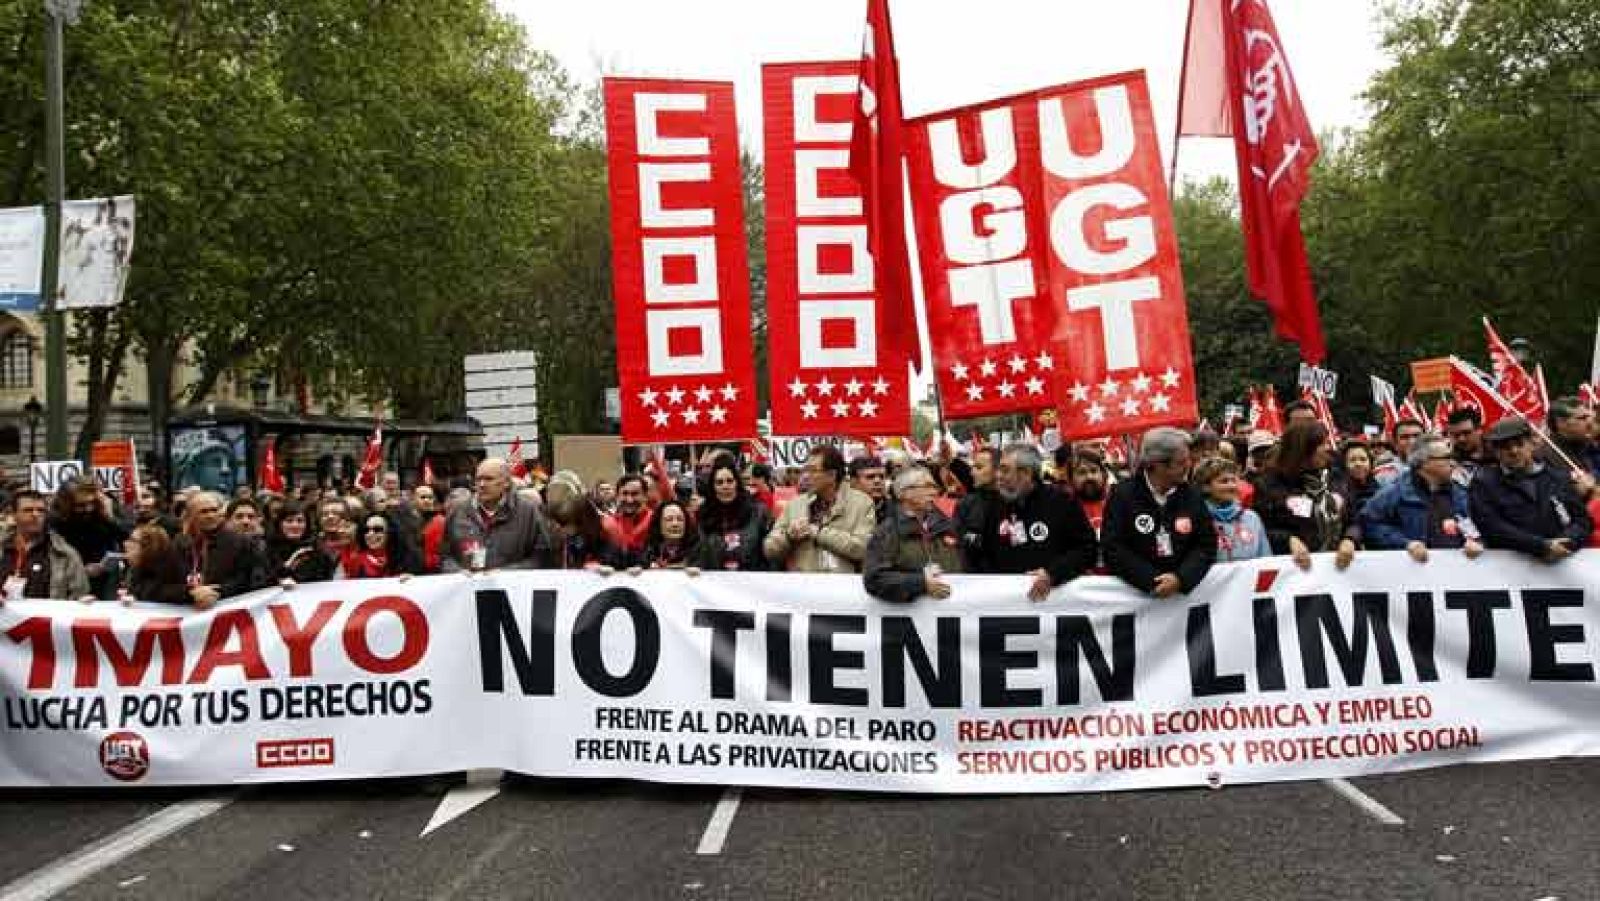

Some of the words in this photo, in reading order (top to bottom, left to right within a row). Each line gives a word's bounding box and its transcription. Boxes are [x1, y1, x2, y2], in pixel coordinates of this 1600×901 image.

[928, 106, 1036, 344] UGT
[1039, 85, 1161, 370] UGT
[476, 586, 661, 698] NO
[694, 608, 1135, 708] TIENEN
[1187, 570, 1595, 698] LÍMITE
[7, 697, 107, 729] LUCHA
[119, 693, 182, 727] POR
[193, 689, 249, 723] TUS
[260, 680, 432, 720] DERECHOS
[595, 708, 672, 733] FRENTE
[678, 711, 708, 735] AL
[716, 712, 808, 737] DRAMA
[815, 716, 861, 740] DEL
[868, 719, 936, 741] PARO
[958, 711, 1145, 742] REACTIVACIÓN
[1153, 704, 1309, 735] ECONÓMICA
[1315, 704, 1331, 725] Y
[1339, 696, 1432, 723] EMPLEO
[576, 740, 651, 762] FRENTE
[655, 743, 671, 764] A
[678, 744, 721, 766] LAS
[729, 746, 937, 774] PRIVATIZACIONES
[958, 749, 1086, 774] SERVICIOS
[1095, 743, 1214, 770] PÚBLICOS
[1220, 745, 1237, 764] Y
[1246, 732, 1397, 762] PROTECCIÓN
[1405, 727, 1481, 752] SOCIAL
